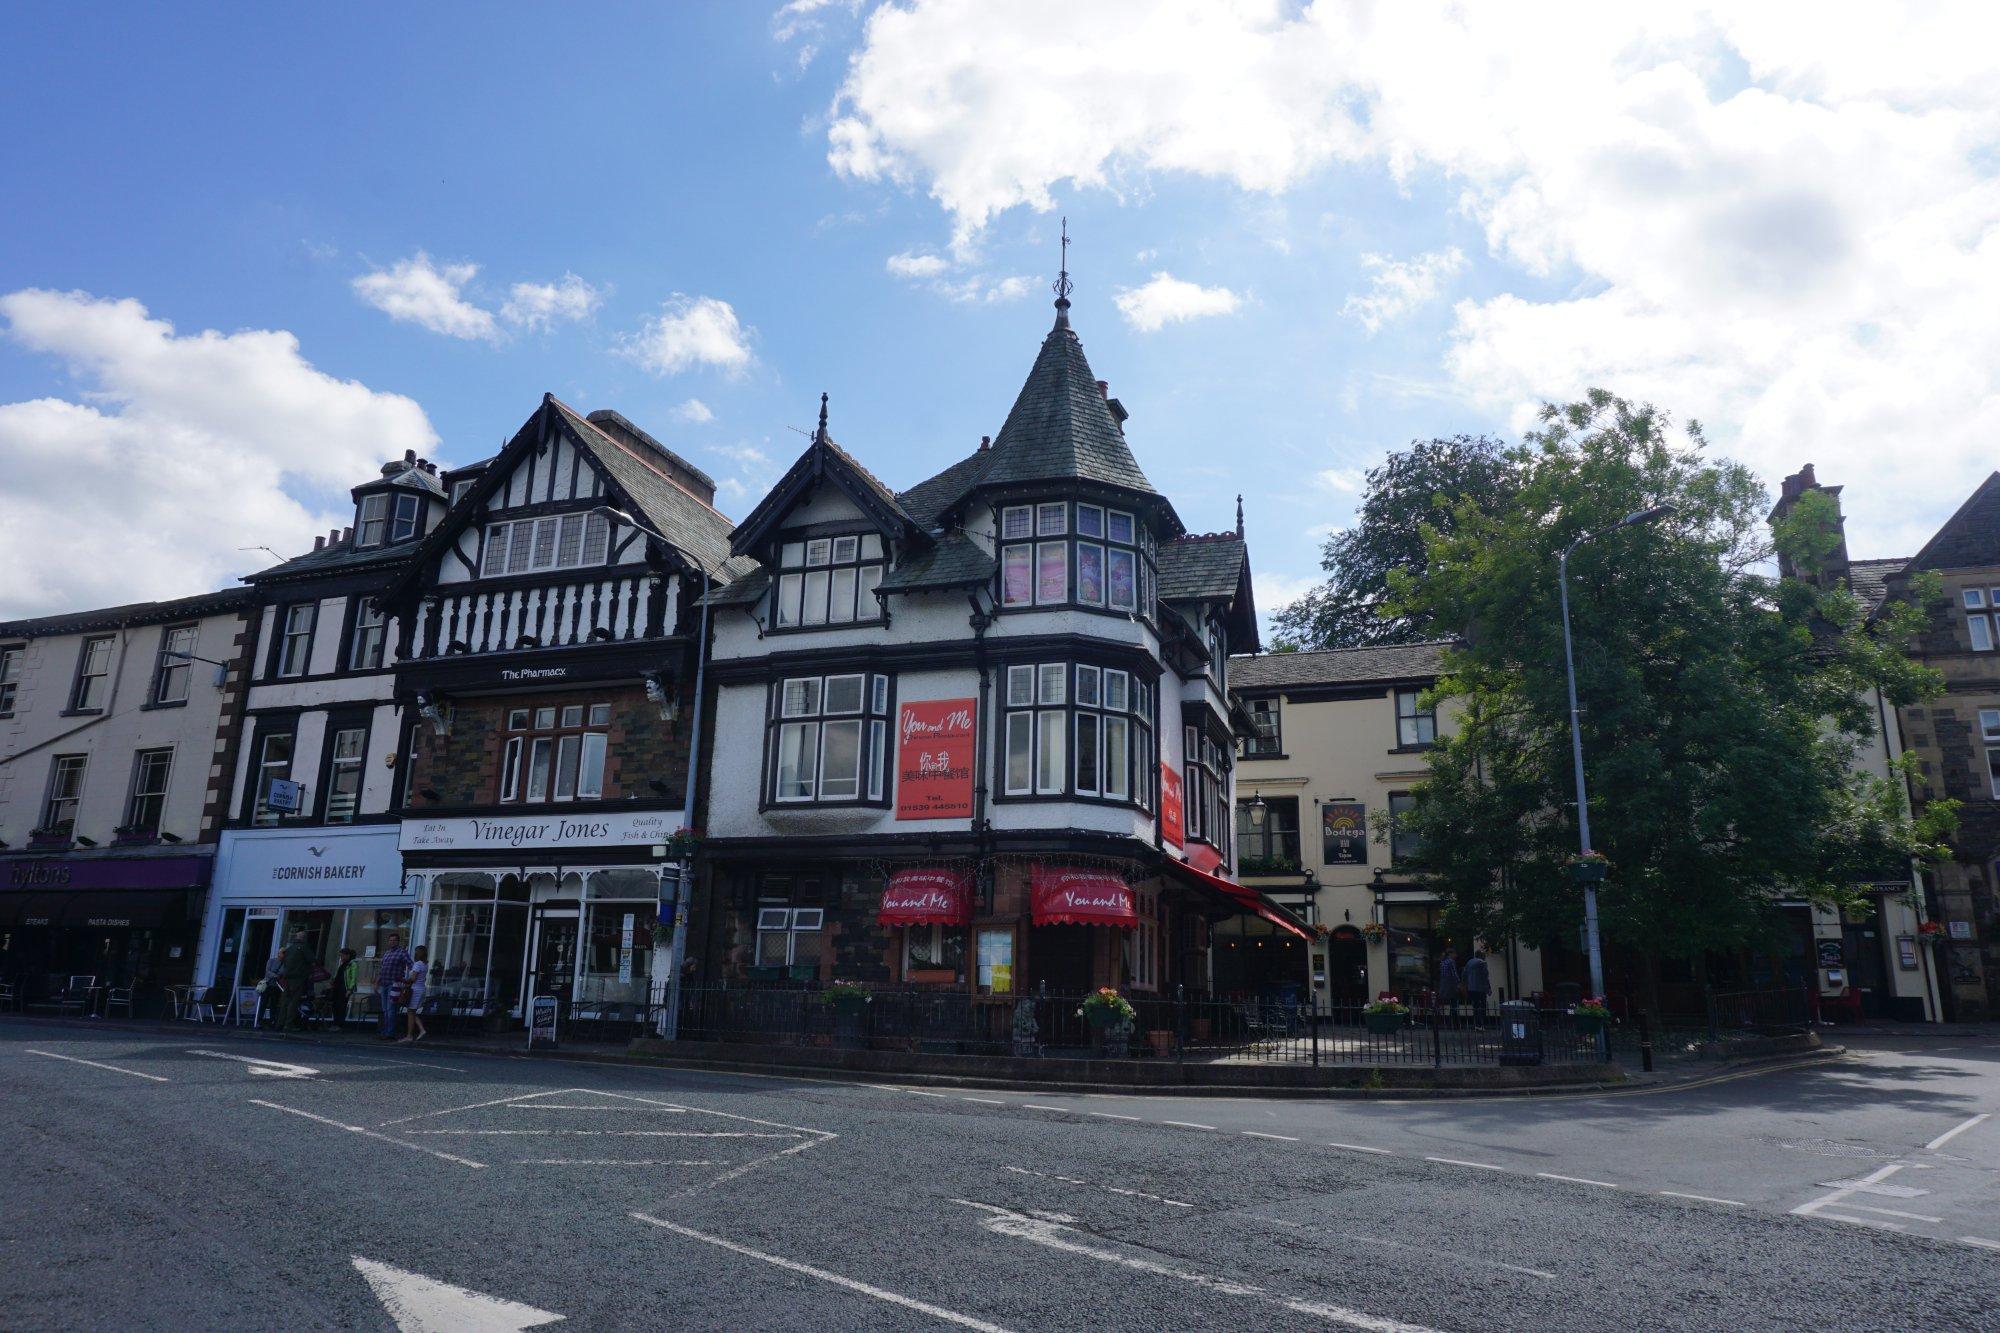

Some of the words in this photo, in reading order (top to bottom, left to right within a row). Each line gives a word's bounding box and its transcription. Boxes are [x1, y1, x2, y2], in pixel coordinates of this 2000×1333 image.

[501, 670, 520, 680] The
[902, 709, 928, 745] You
[927, 718, 943, 732] and
[946, 709, 972, 731] Me
[900, 804, 930, 812] 01539
[424, 824, 435, 832] Eat
[632, 816, 663, 828] Quality
[469, 819, 550, 847] Vinegar
[552, 818, 610, 842] Jones
[622, 830, 639, 841] Fish
[1325, 826, 1365, 838] Bodega
[412, 836, 430, 845] Take
[431, 835, 454, 845] Away
[10, 861, 73, 889] hyltons
[277, 866, 323, 880] CORNISH
[324, 865, 366, 879] BAKERY
[882, 894, 899, 910] You
[900, 893, 926, 908] and
[928, 892, 948, 910] Me
[1065, 891, 1090, 907] You
[1092, 893, 1116, 906] and
[24, 918, 49, 926] STEAKS
[87, 918, 107, 926] PASTA
[107, 918, 130, 926] DISHES
